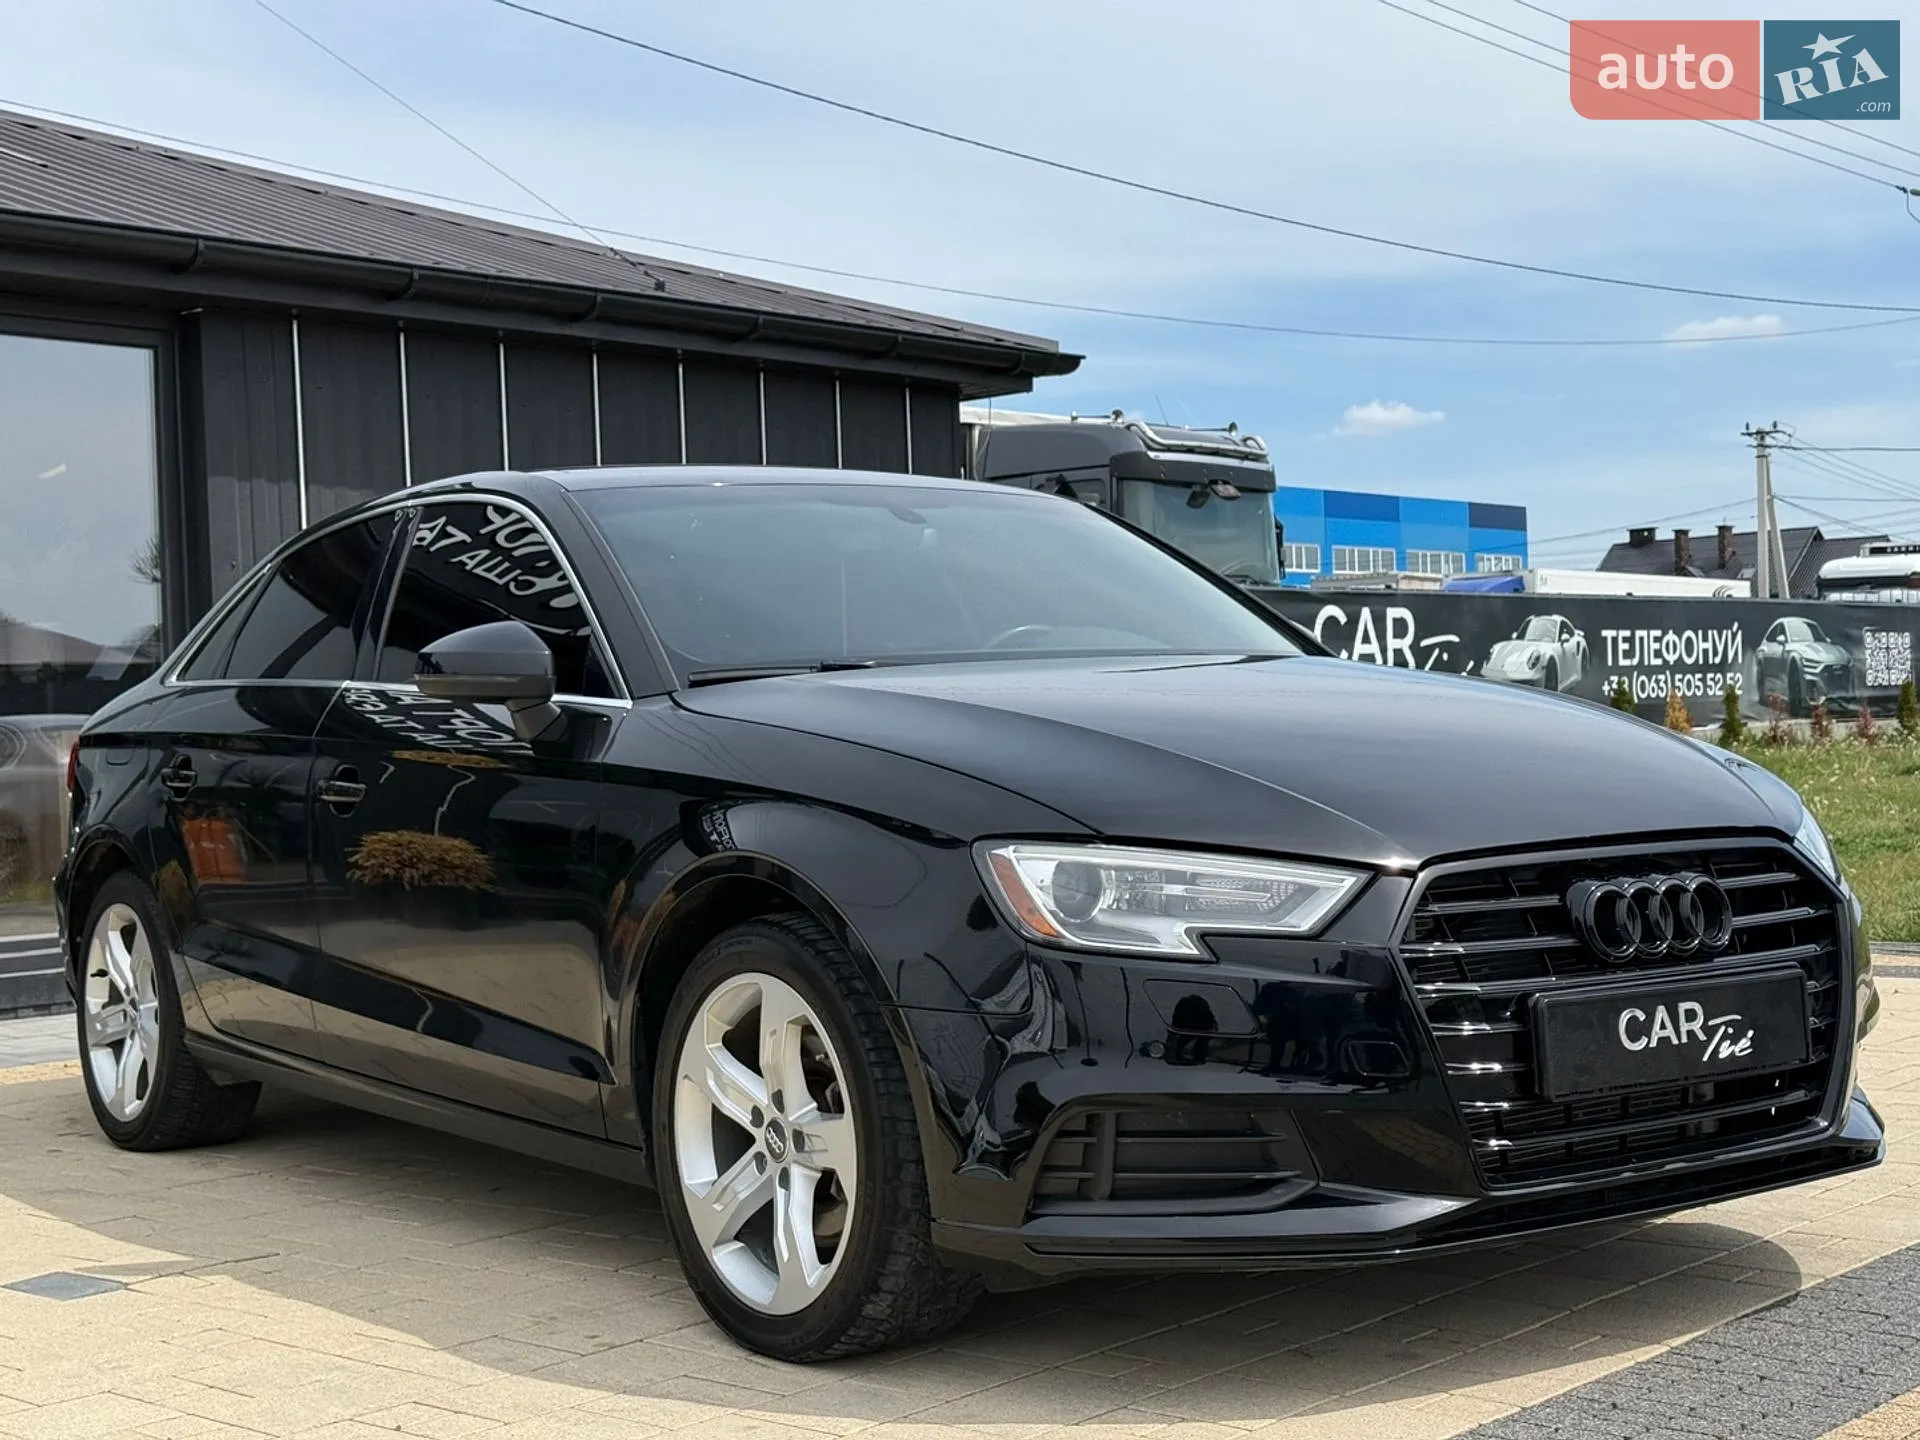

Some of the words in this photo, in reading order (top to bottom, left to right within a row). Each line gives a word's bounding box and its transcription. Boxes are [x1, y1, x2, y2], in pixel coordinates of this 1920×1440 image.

[1601, 621, 1743, 667] ТЕЛЕФОНУЙ
[1632, 670, 1672, 703] (063)
[1674, 672, 1704, 697] 505
[1706, 673, 1724, 696] 52
[1618, 1001, 1708, 1051] CAR
